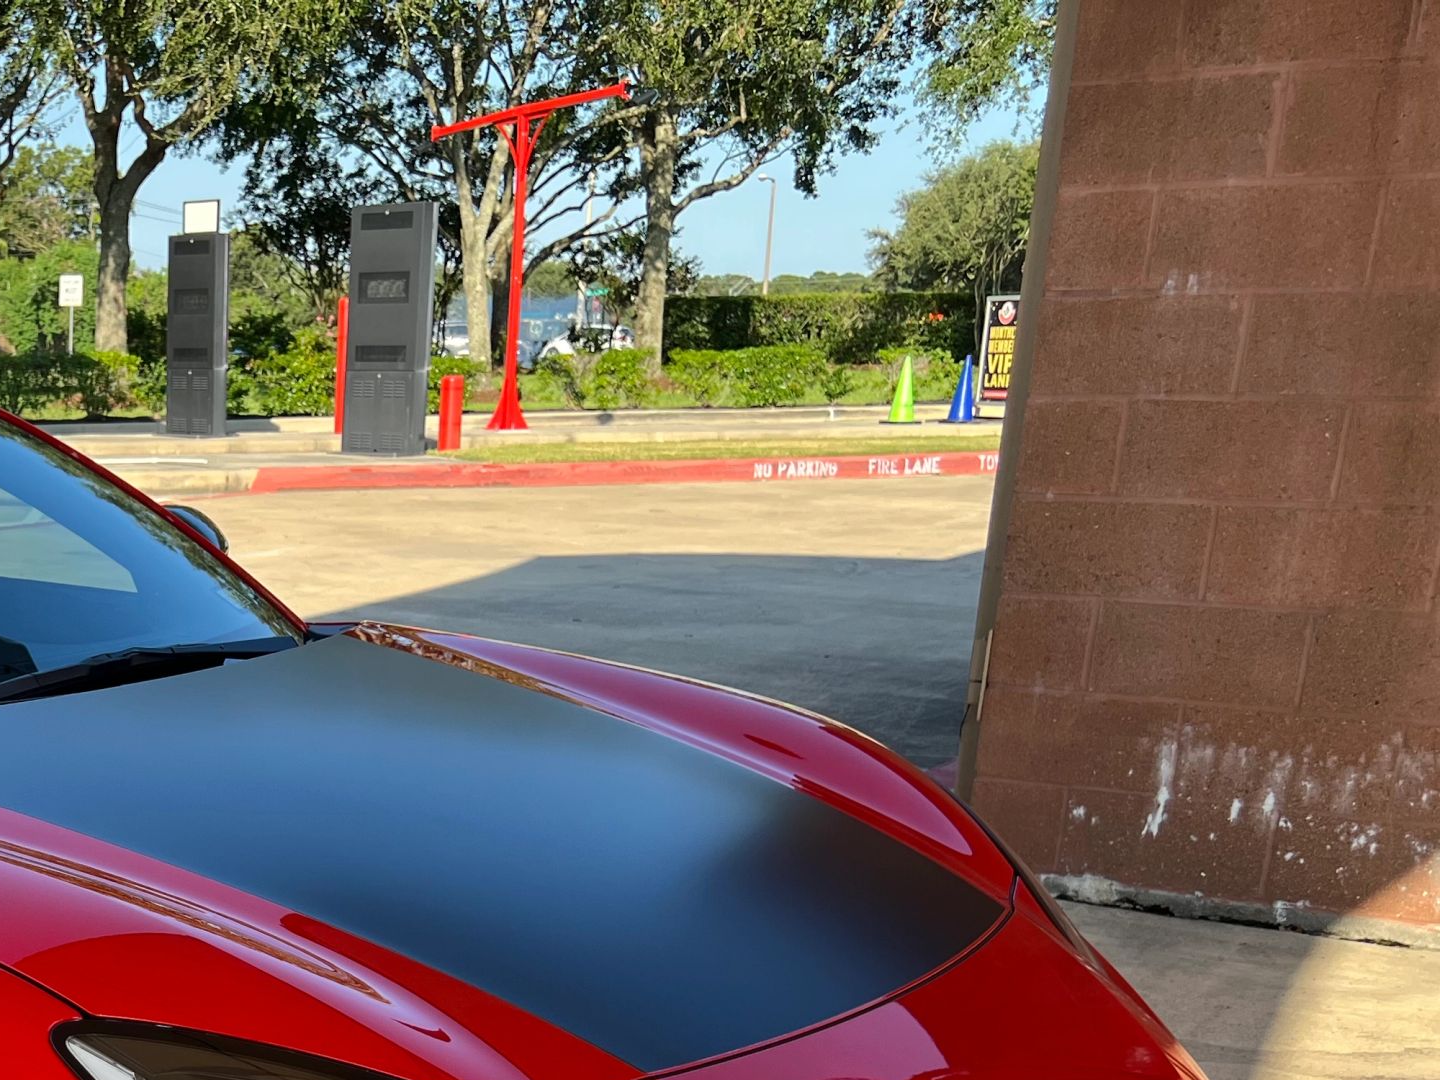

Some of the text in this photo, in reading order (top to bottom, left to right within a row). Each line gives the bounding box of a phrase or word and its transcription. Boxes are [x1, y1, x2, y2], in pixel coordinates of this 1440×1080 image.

[753, 462, 772, 479] NO
[777, 460, 838, 479] PARKING
[868, 458, 899, 475] FIRE
[904, 456, 941, 475] LANE
